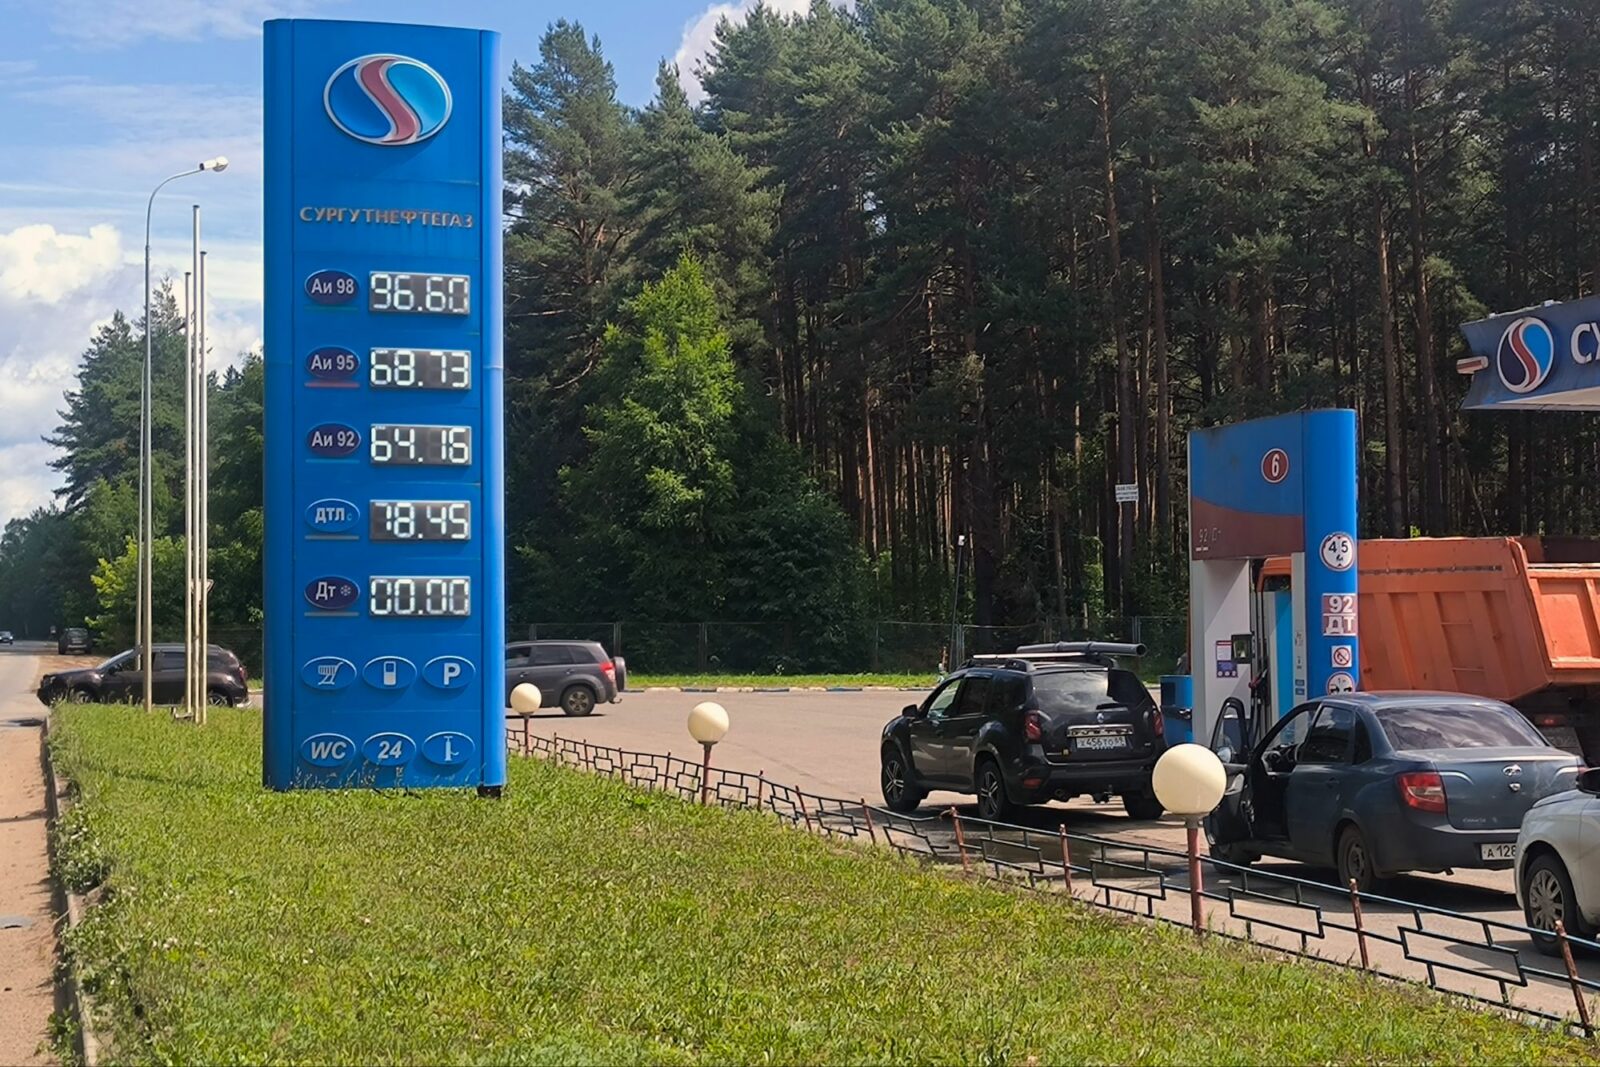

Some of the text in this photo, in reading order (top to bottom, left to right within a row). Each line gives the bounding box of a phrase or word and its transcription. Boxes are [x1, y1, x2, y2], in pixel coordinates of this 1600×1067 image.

[300, 206, 473, 228] СУРГУТНЕФТЕГАЗ
[311, 278, 355, 295] Аи 98
[370, 273, 469, 312] 96.60
[311, 355, 355, 370] Аи 95
[370, 350, 469, 387] 68.73
[311, 432, 355, 447] Аи 92
[370, 425, 469, 463] 64.16
[1270, 454, 1280, 478] 6
[315, 582, 337, 600] Дт
[370, 579, 469, 615] 00.00
[1328, 596, 1353, 613] 92
[1326, 616, 1355, 634] ДТ
[443, 662, 461, 686] P
[311, 741, 347, 760] WC
[378, 741, 402, 758] 24
